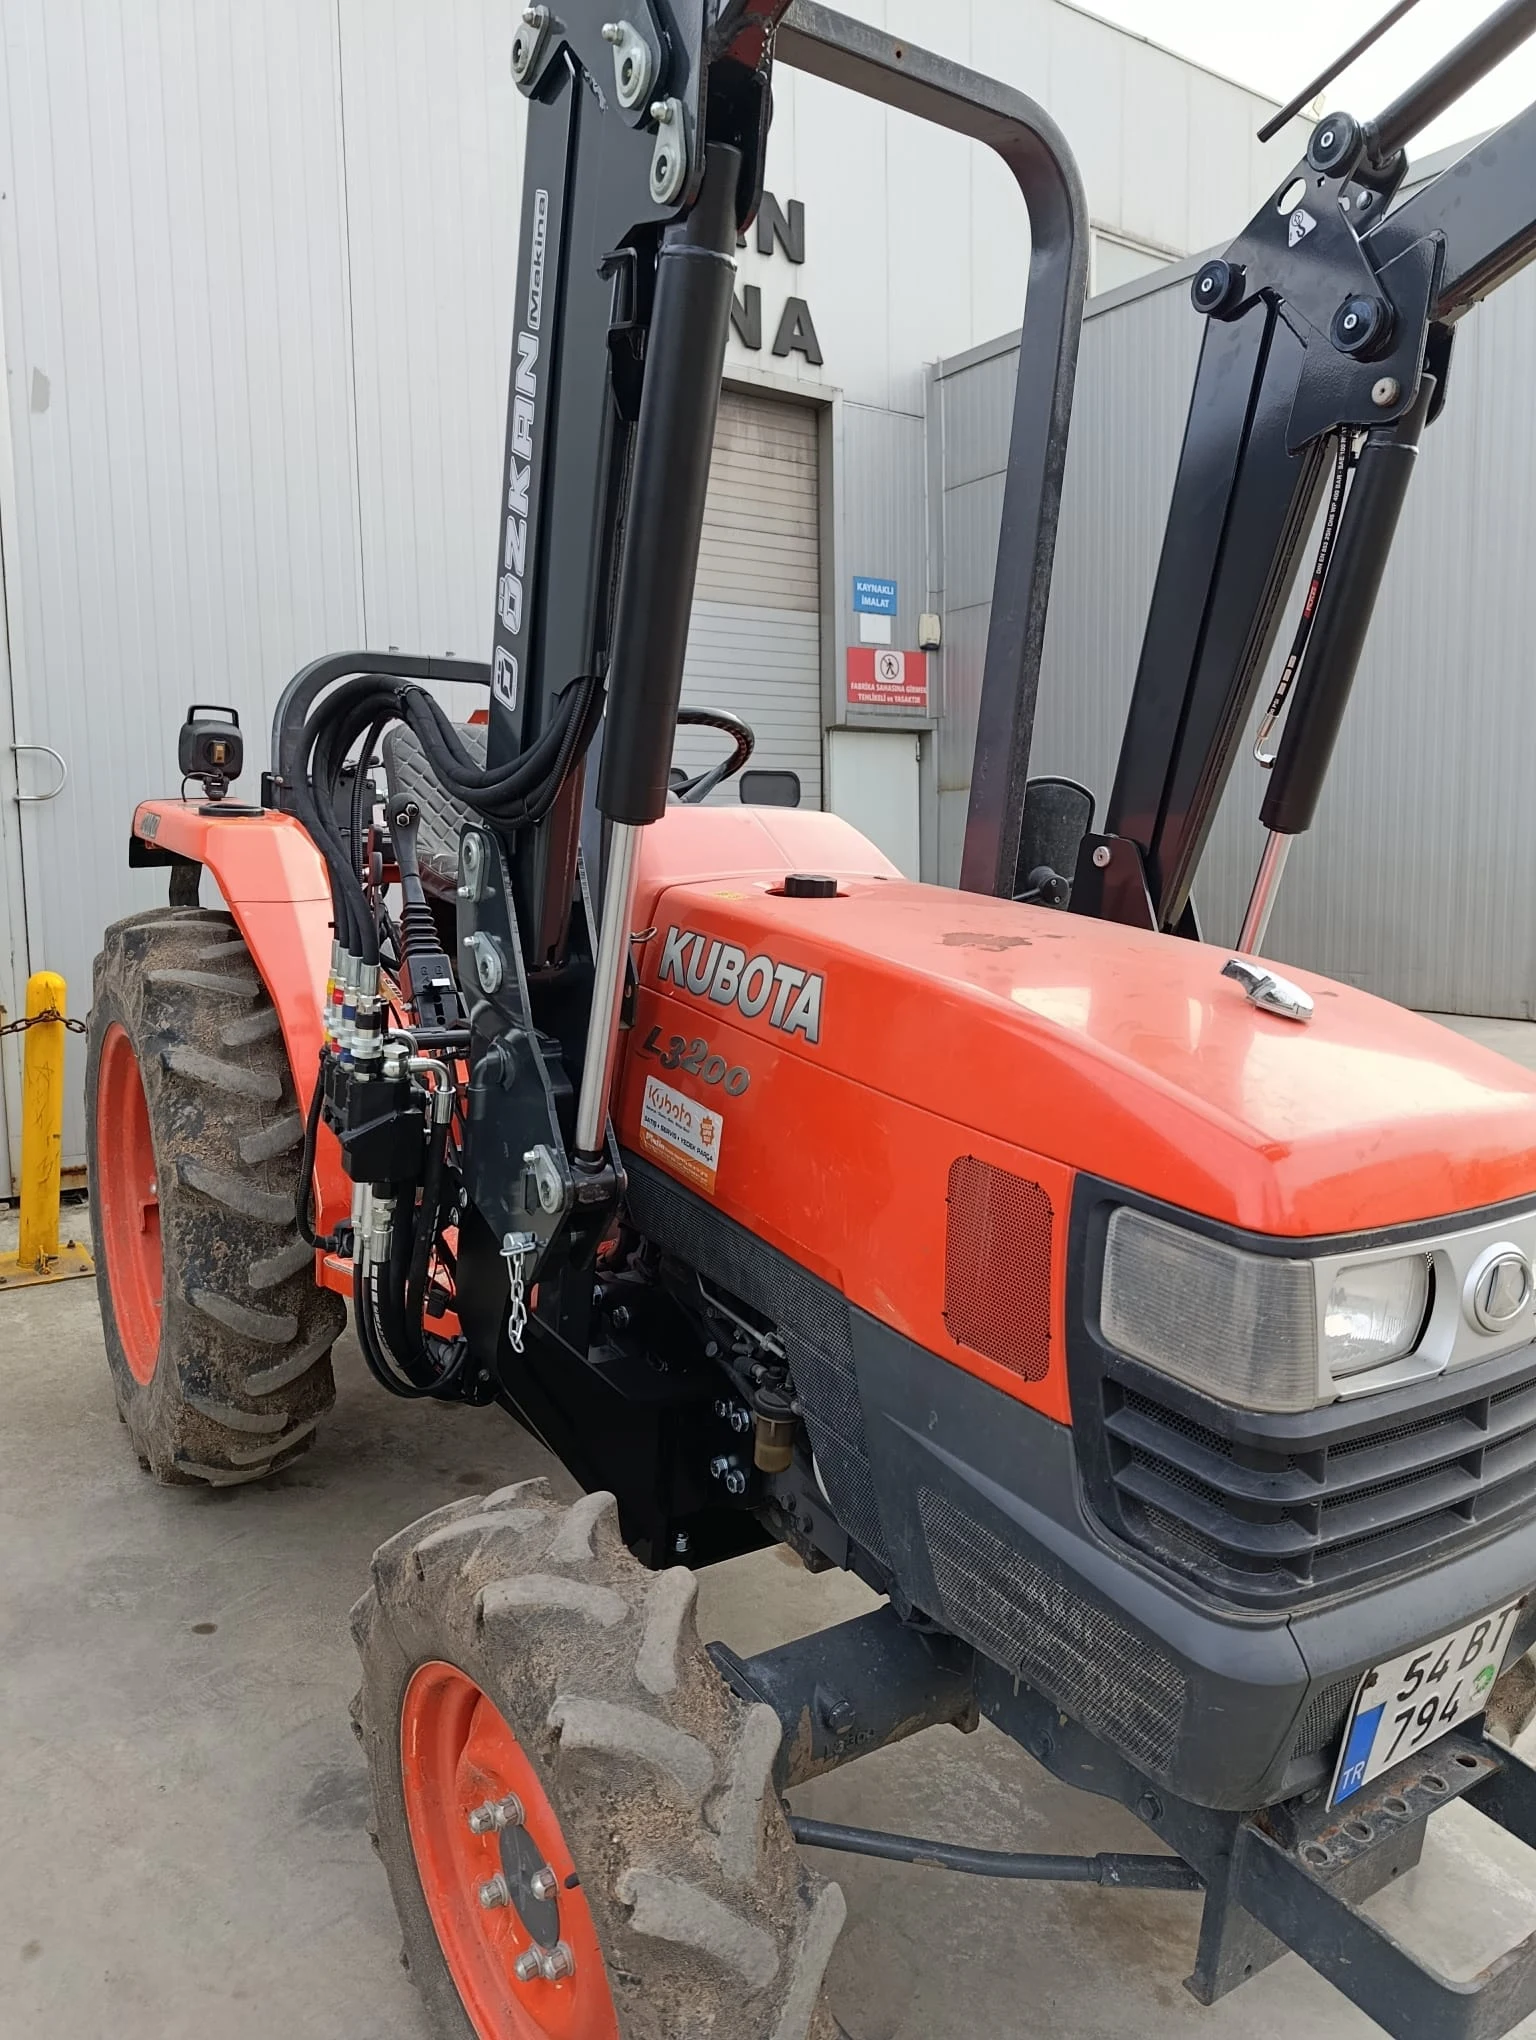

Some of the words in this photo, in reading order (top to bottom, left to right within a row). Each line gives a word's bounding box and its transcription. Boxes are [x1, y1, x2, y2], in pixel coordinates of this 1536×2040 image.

[529, 196, 547, 324] Makina
[497, 331, 540, 636] ÖZKAN
[856, 582, 894, 595] KAYNAKLI
[861, 595, 890, 608] İMALAT
[657, 924, 824, 1045] KUBOTA
[642, 1024, 751, 1097] L3200
[647, 1084, 693, 1128] Kubota
[680, 1137, 696, 1151] YEDEK
[696, 1147, 714, 1162] PARÇA
[1396, 1638, 1457, 1702] 54
[1456, 1605, 1517, 1672] BT
[1384, 1678, 1464, 1764] 794
[1342, 1760, 1366, 1790] TR
